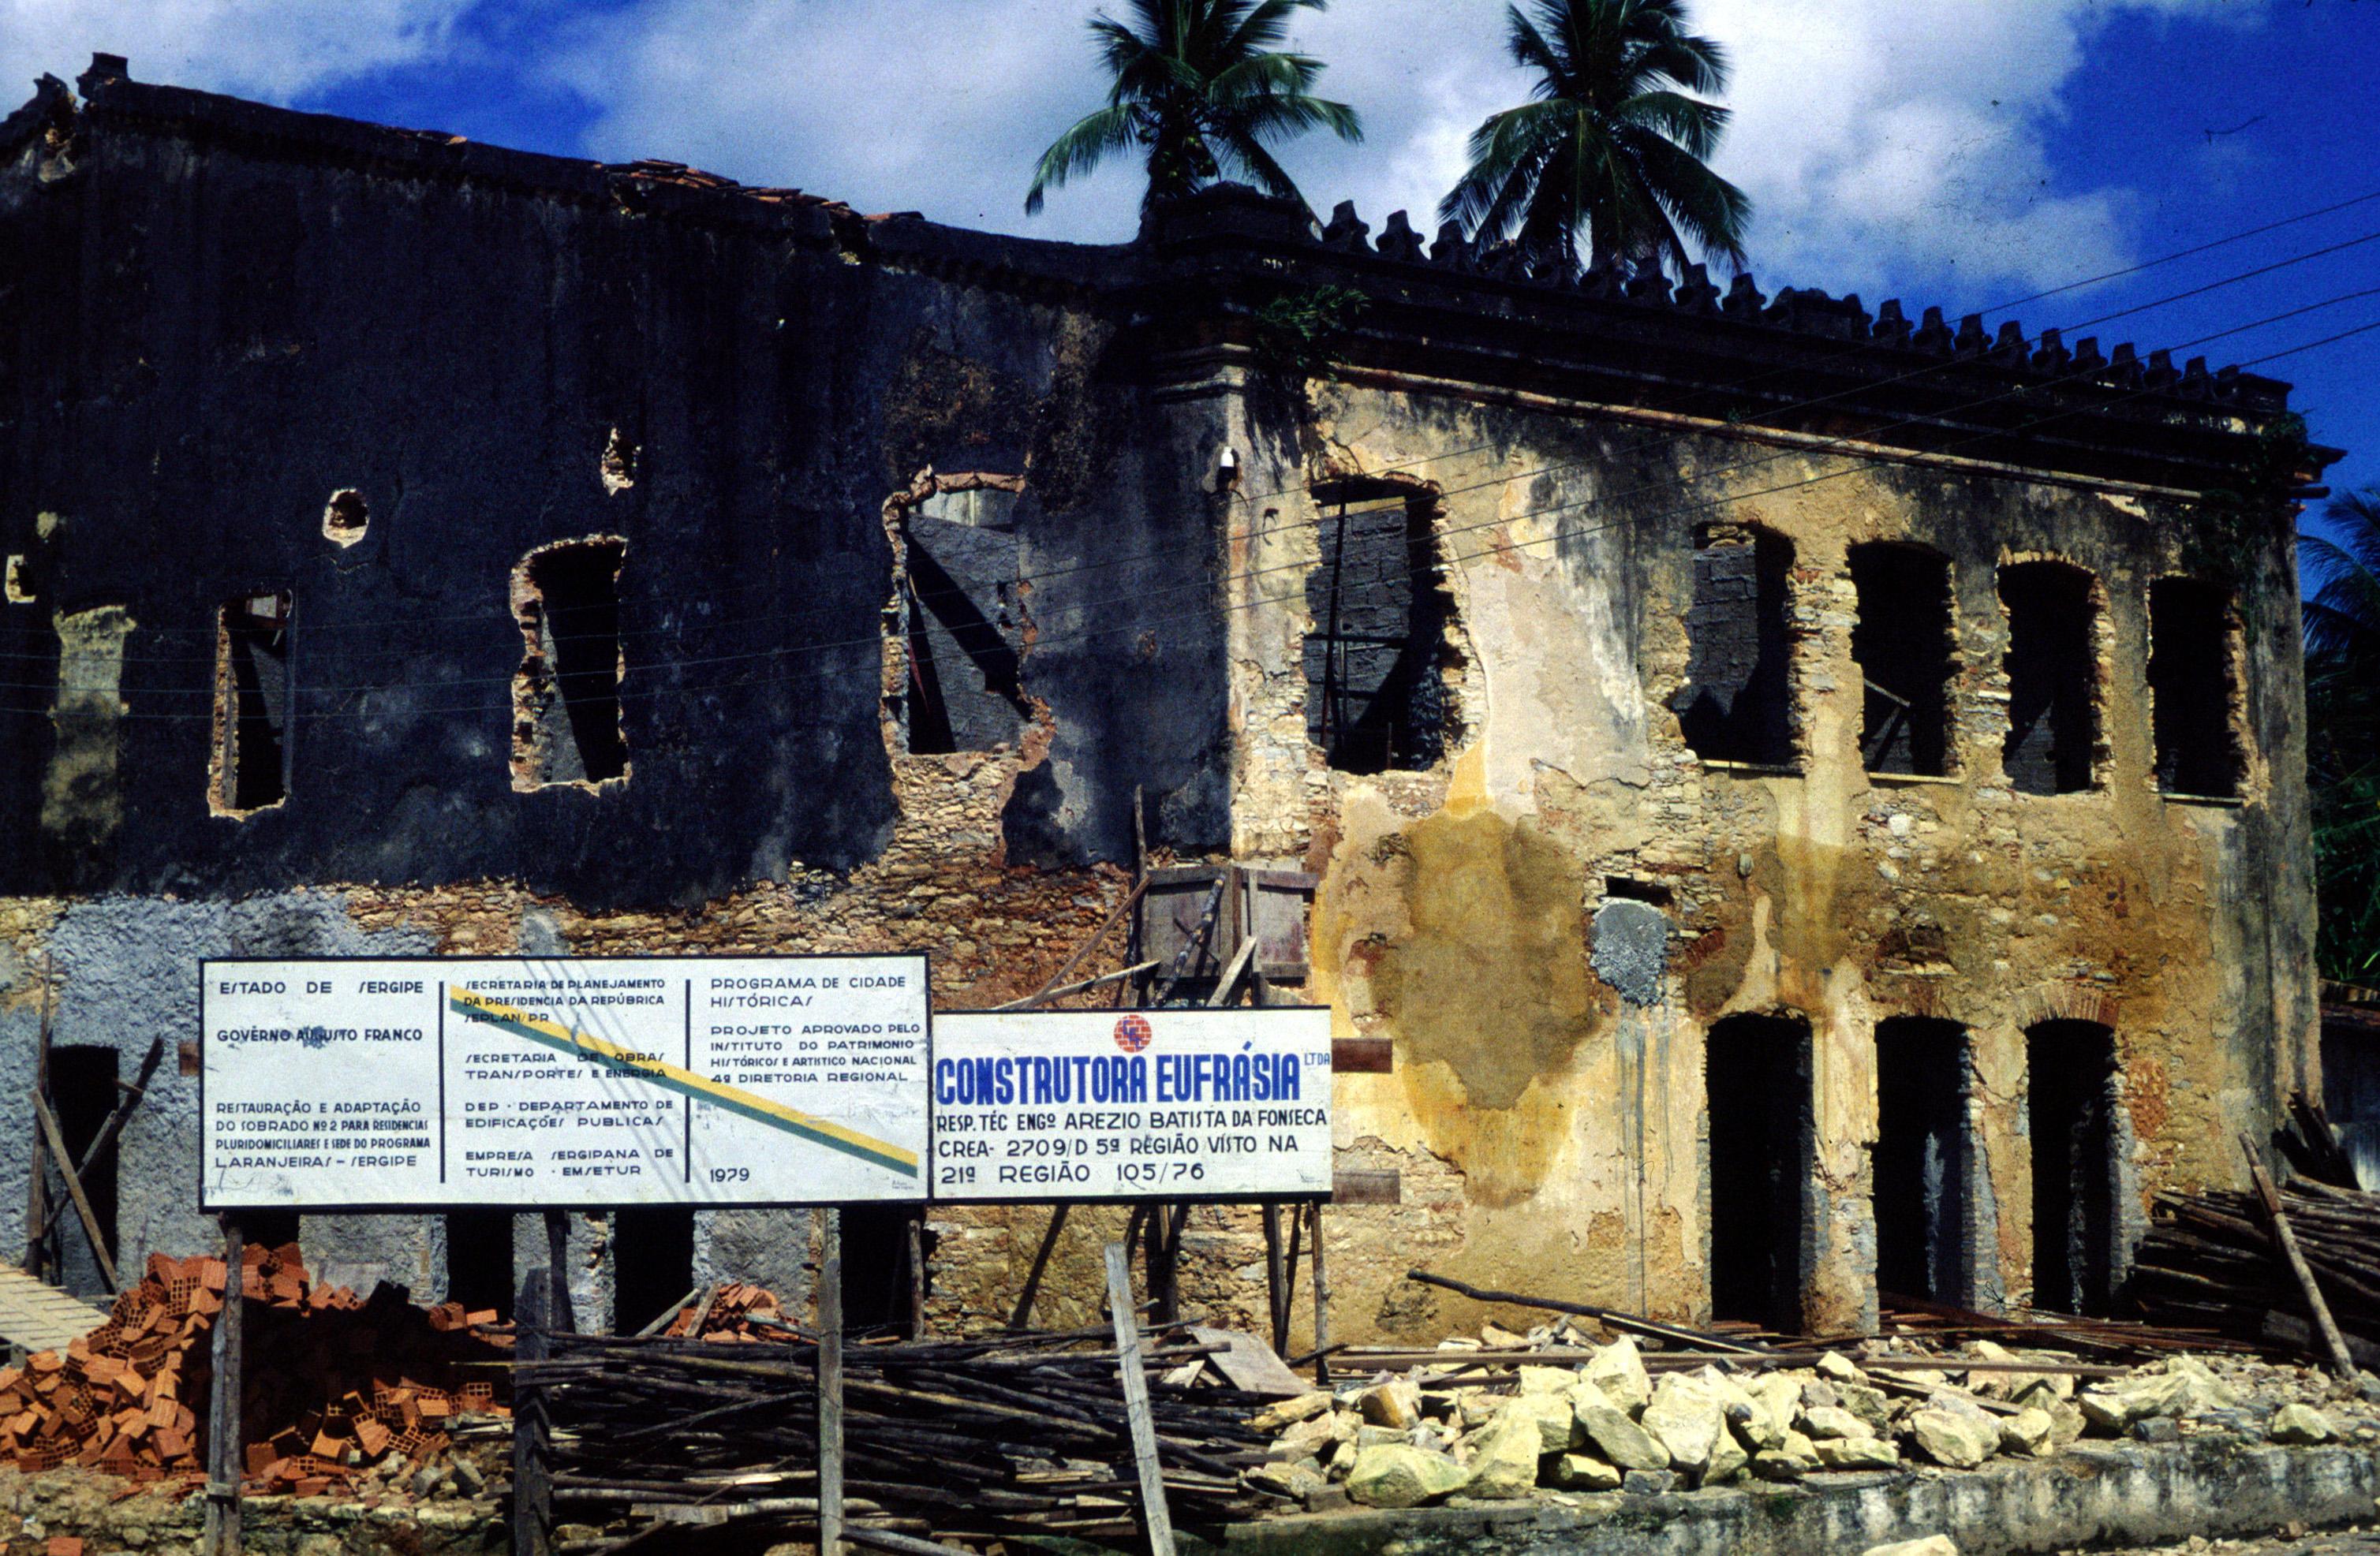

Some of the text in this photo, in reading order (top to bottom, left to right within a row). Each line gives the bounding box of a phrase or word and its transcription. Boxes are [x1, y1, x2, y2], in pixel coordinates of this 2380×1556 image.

[219, 981, 424, 994] ESTADO DE SERGIPE
[465, 979, 665, 990] SECRETARIA DE PLANEJAMENTO
[711, 976, 906, 990] PROGRAMA DE CIDADE
[464, 997, 480, 1006] DA
[485, 997, 564, 1006] PRESIDENCIA
[569, 996, 588, 1006] DA
[711, 993, 813, 1008] HISTÓRICAS
[296, 1028, 358, 1043] AUGUSTO
[364, 1029, 423, 1041] FRANCO
[711, 1024, 920, 1035] PROJETO APROVADO PELO
[710, 1039, 914, 1051] INSTITUTO DO PATRIMONIO
[465, 1053, 664, 1063] SECRETARIA DE OBRAS
[710, 1055, 778, 1067] HISTÓRICOS
[783, 1057, 789, 1066] E
[851, 1056, 917, 1065] NACIONAL
[465, 1069, 667, 1080] TRANSPORTES E ENERGIA
[738, 1073, 818, 1084] DIRETORIA
[827, 1072, 908, 1083] REGIONAL
[936, 1055, 1148, 1106] CONSTRUTORA
[1156, 1040, 1300, 1103] EUFRÁSIA
[216, 1099, 420, 1116] RESTAURAÇÃO E ADAPTAÇÃO
[465, 1102, 499, 1112] DEP
[518, 1100, 648, 1111] DEPARTAMENTO
[656, 1100, 673, 1110] DE
[215, 1121, 235, 1132] DO
[241, 1120, 308, 1132] SOBRADO
[329, 1120, 338, 1131] 2
[341, 1120, 369, 1131] PARA
[373, 1120, 428, 1131] RESIDENCIAS
[577, 1116, 663, 1127] PUBLICAS
[936, 1114, 976, 1132] RESP.
[981, 1110, 1008, 1132] TÉC
[1064, 1112, 1140, 1129] AREZIO
[1150, 1111, 1227, 1129] BATISTA
[1232, 1110, 1253, 1127] DA
[1258, 1109, 1328, 1127] FONSECA
[215, 1137, 430, 1150] PLURIDOMICILIARES E SEDE DO PROGRAMA
[1130, 1132, 1198, 1155] REGIÃO
[1268, 1135, 1298, 1152] NA
[465, 1148, 674, 1161] EMPRESA SERGIPANA DE
[215, 1155, 332, 1168] LARANJEIRAS
[351, 1155, 417, 1167] SERGIPE
[465, 1167, 534, 1177] TURISMO
[562, 1166, 641, 1176] EMSETUR
[710, 1168, 750, 1182] 1979
[999, 1160, 1090, 1183] REGIÃO
[1117, 1162, 1205, 1185] 105/76
